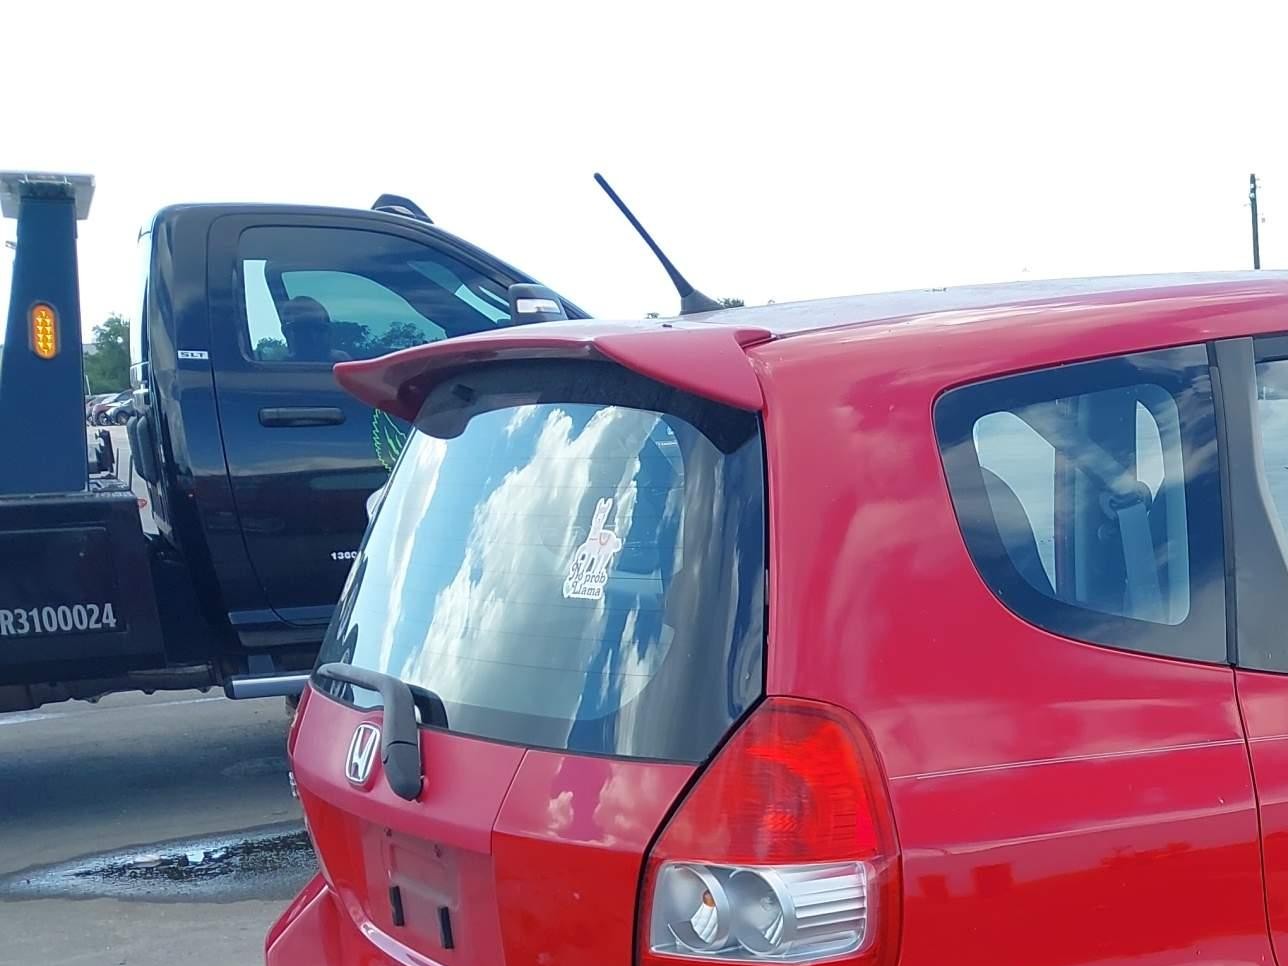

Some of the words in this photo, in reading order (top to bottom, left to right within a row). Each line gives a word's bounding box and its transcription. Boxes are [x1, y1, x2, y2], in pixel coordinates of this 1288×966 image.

[179, 351, 206, 359] SLT
[569, 560, 584, 581] No
[584, 570, 606, 585] prob
[571, 581, 601, 597] Llama
[0, 603, 117, 635] R3100024
